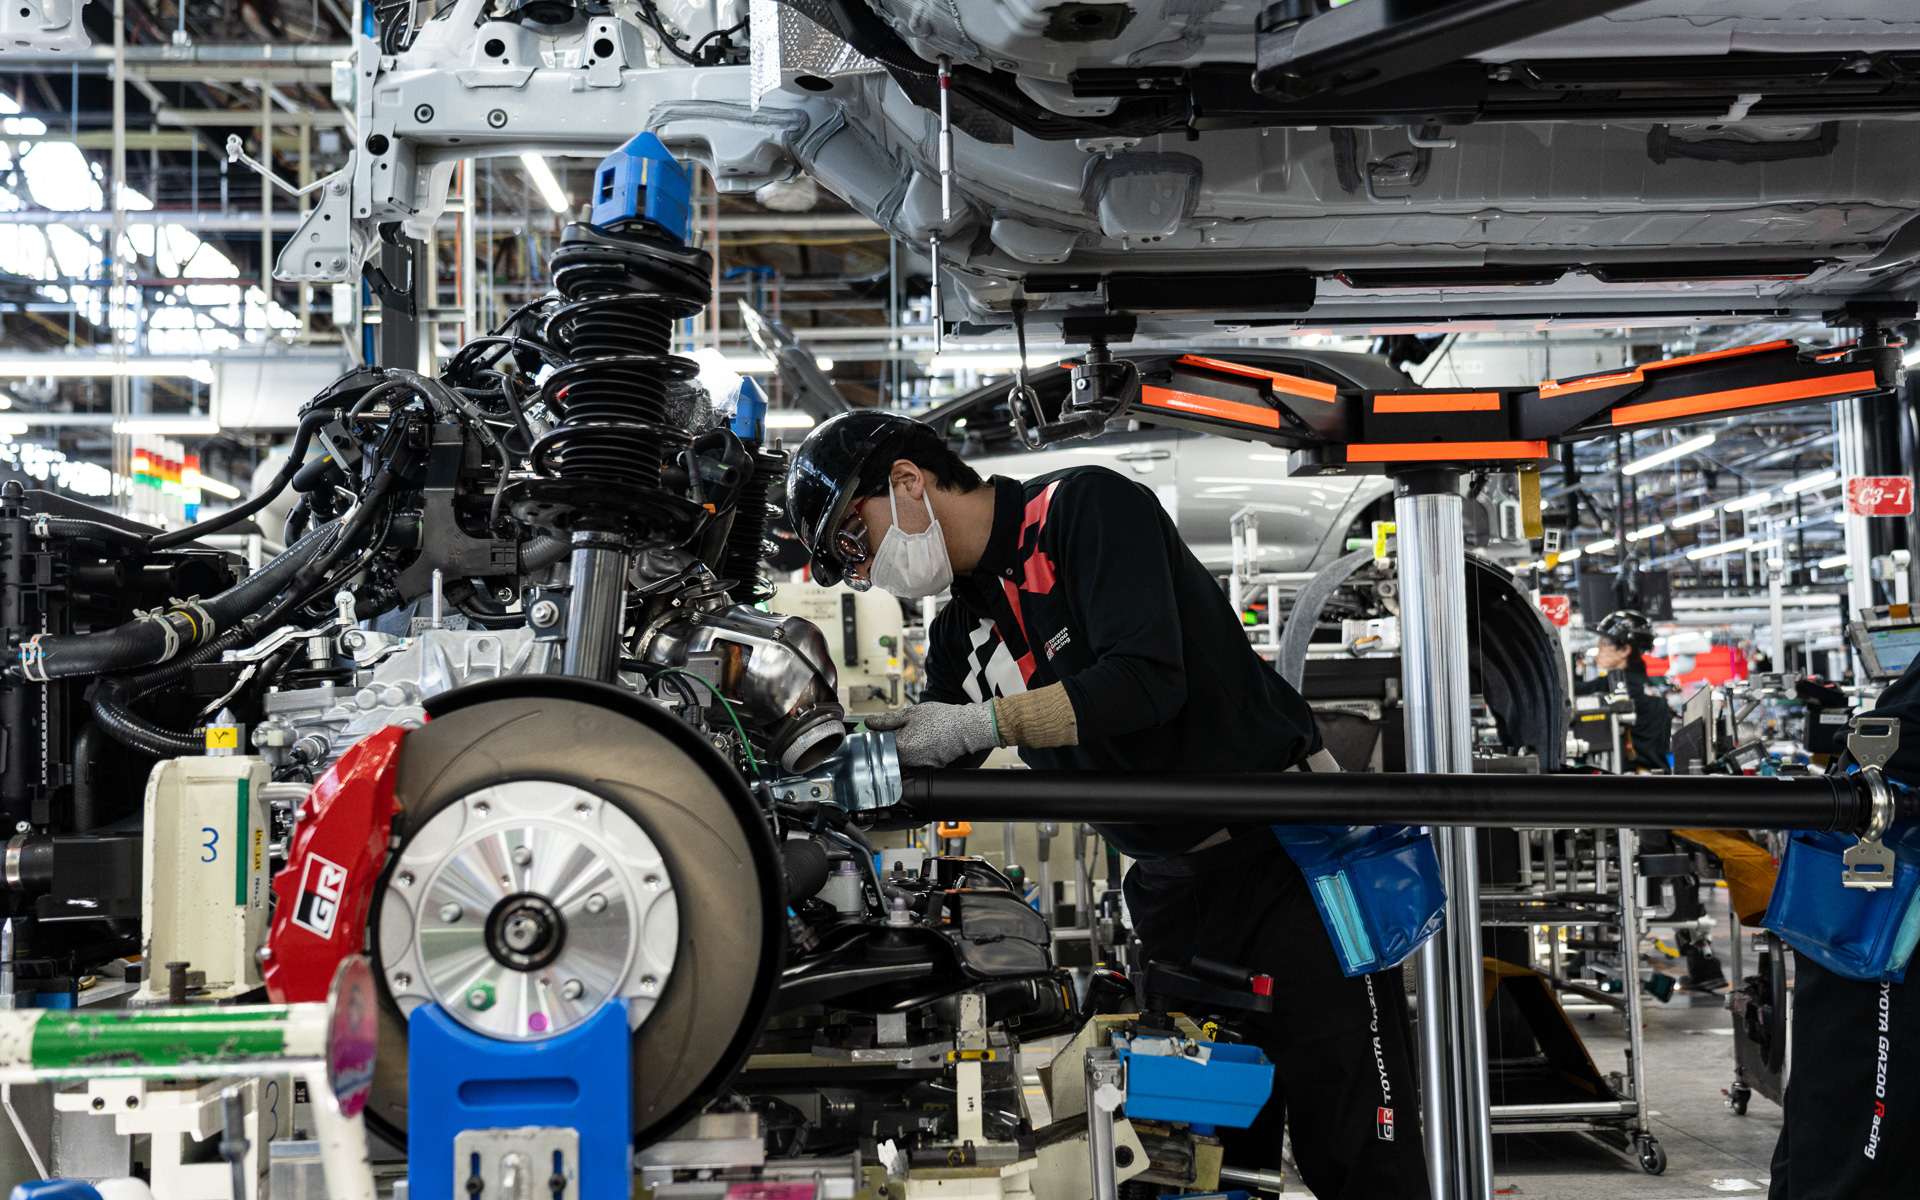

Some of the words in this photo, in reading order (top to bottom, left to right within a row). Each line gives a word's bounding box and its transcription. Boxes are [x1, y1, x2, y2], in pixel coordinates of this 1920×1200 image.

[1859, 487, 1906, 505] C3-1
[201, 827, 219, 863] 3
[308, 865, 343, 932] GR
[1365, 973, 1379, 1033] GAZOO
[1878, 981, 1890, 1032] OYOTA
[1373, 1036, 1392, 1104] TOYOTA
[1875, 1035, 1890, 1099] GAZOO
[265, 1080, 279, 1142] 3
[1382, 1108, 1394, 1140] GR
[1864, 1100, 1885, 1160] Racing
